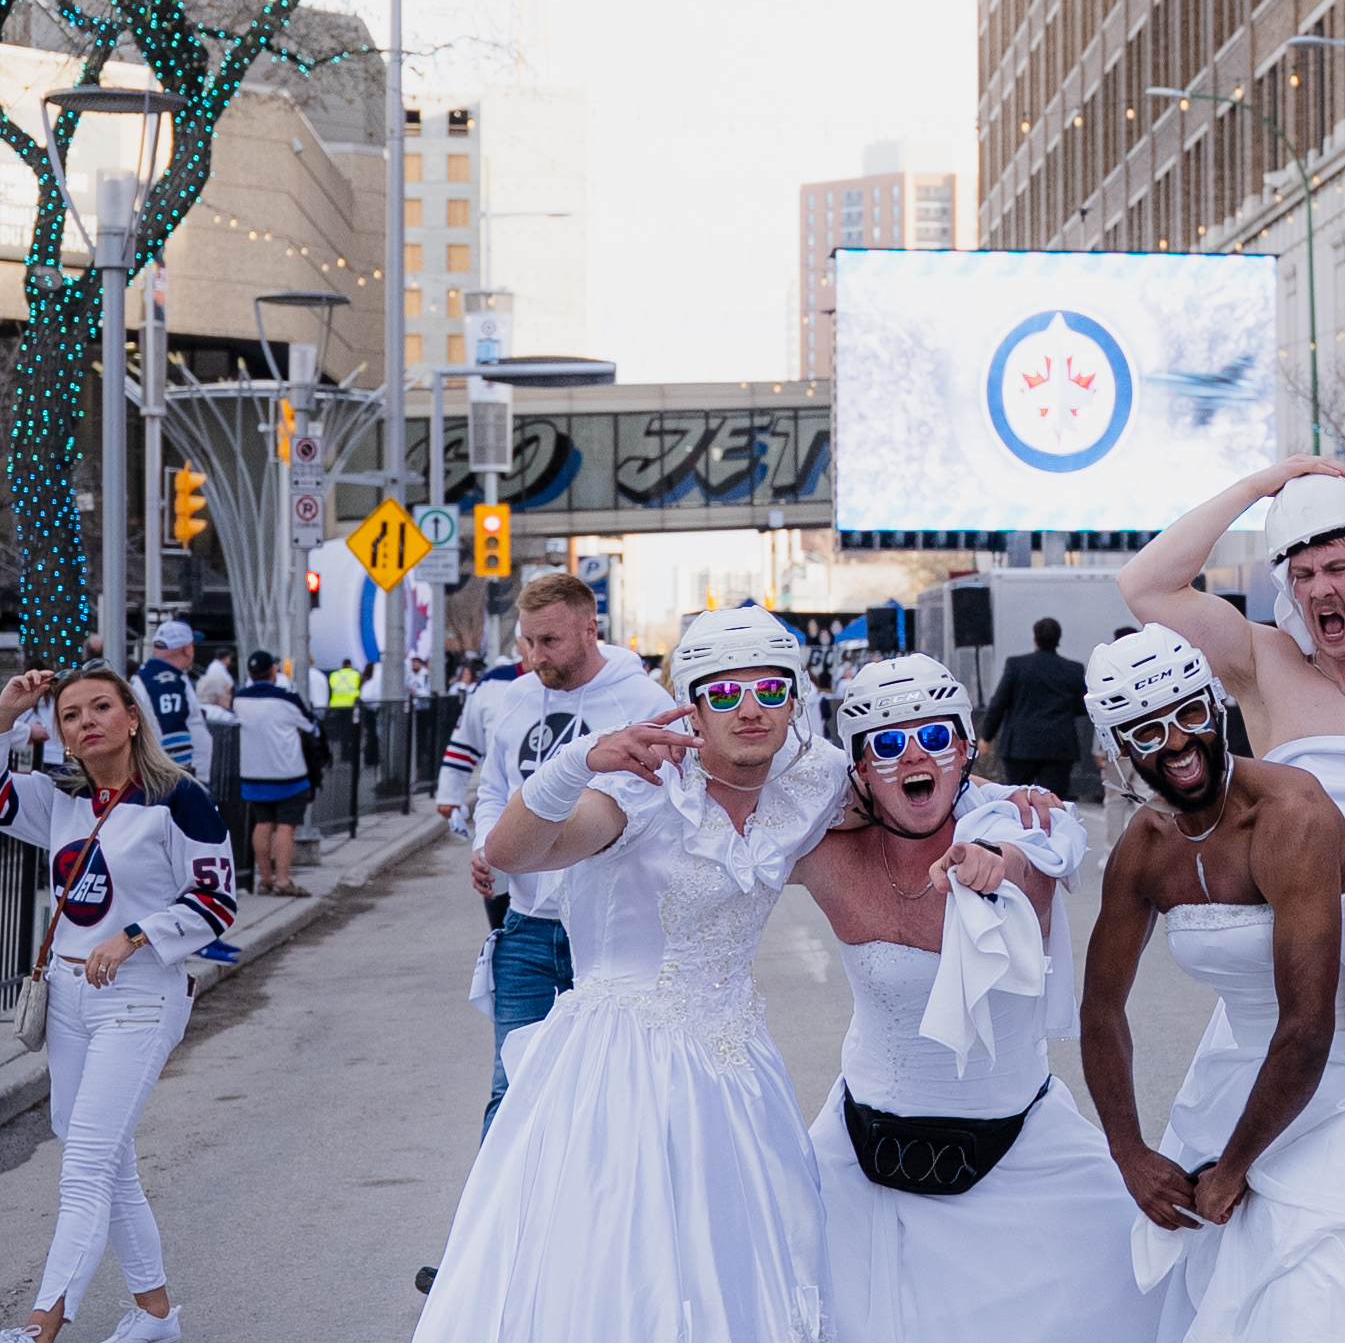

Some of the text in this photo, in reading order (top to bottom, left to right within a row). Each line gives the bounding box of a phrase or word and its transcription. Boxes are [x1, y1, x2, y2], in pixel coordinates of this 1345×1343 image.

[616, 412, 829, 504] JET
[1135, 668, 1172, 690] CCM
[160, 693, 182, 714] 67
[878, 691, 920, 707] CCM
[193, 857, 232, 893] 57
